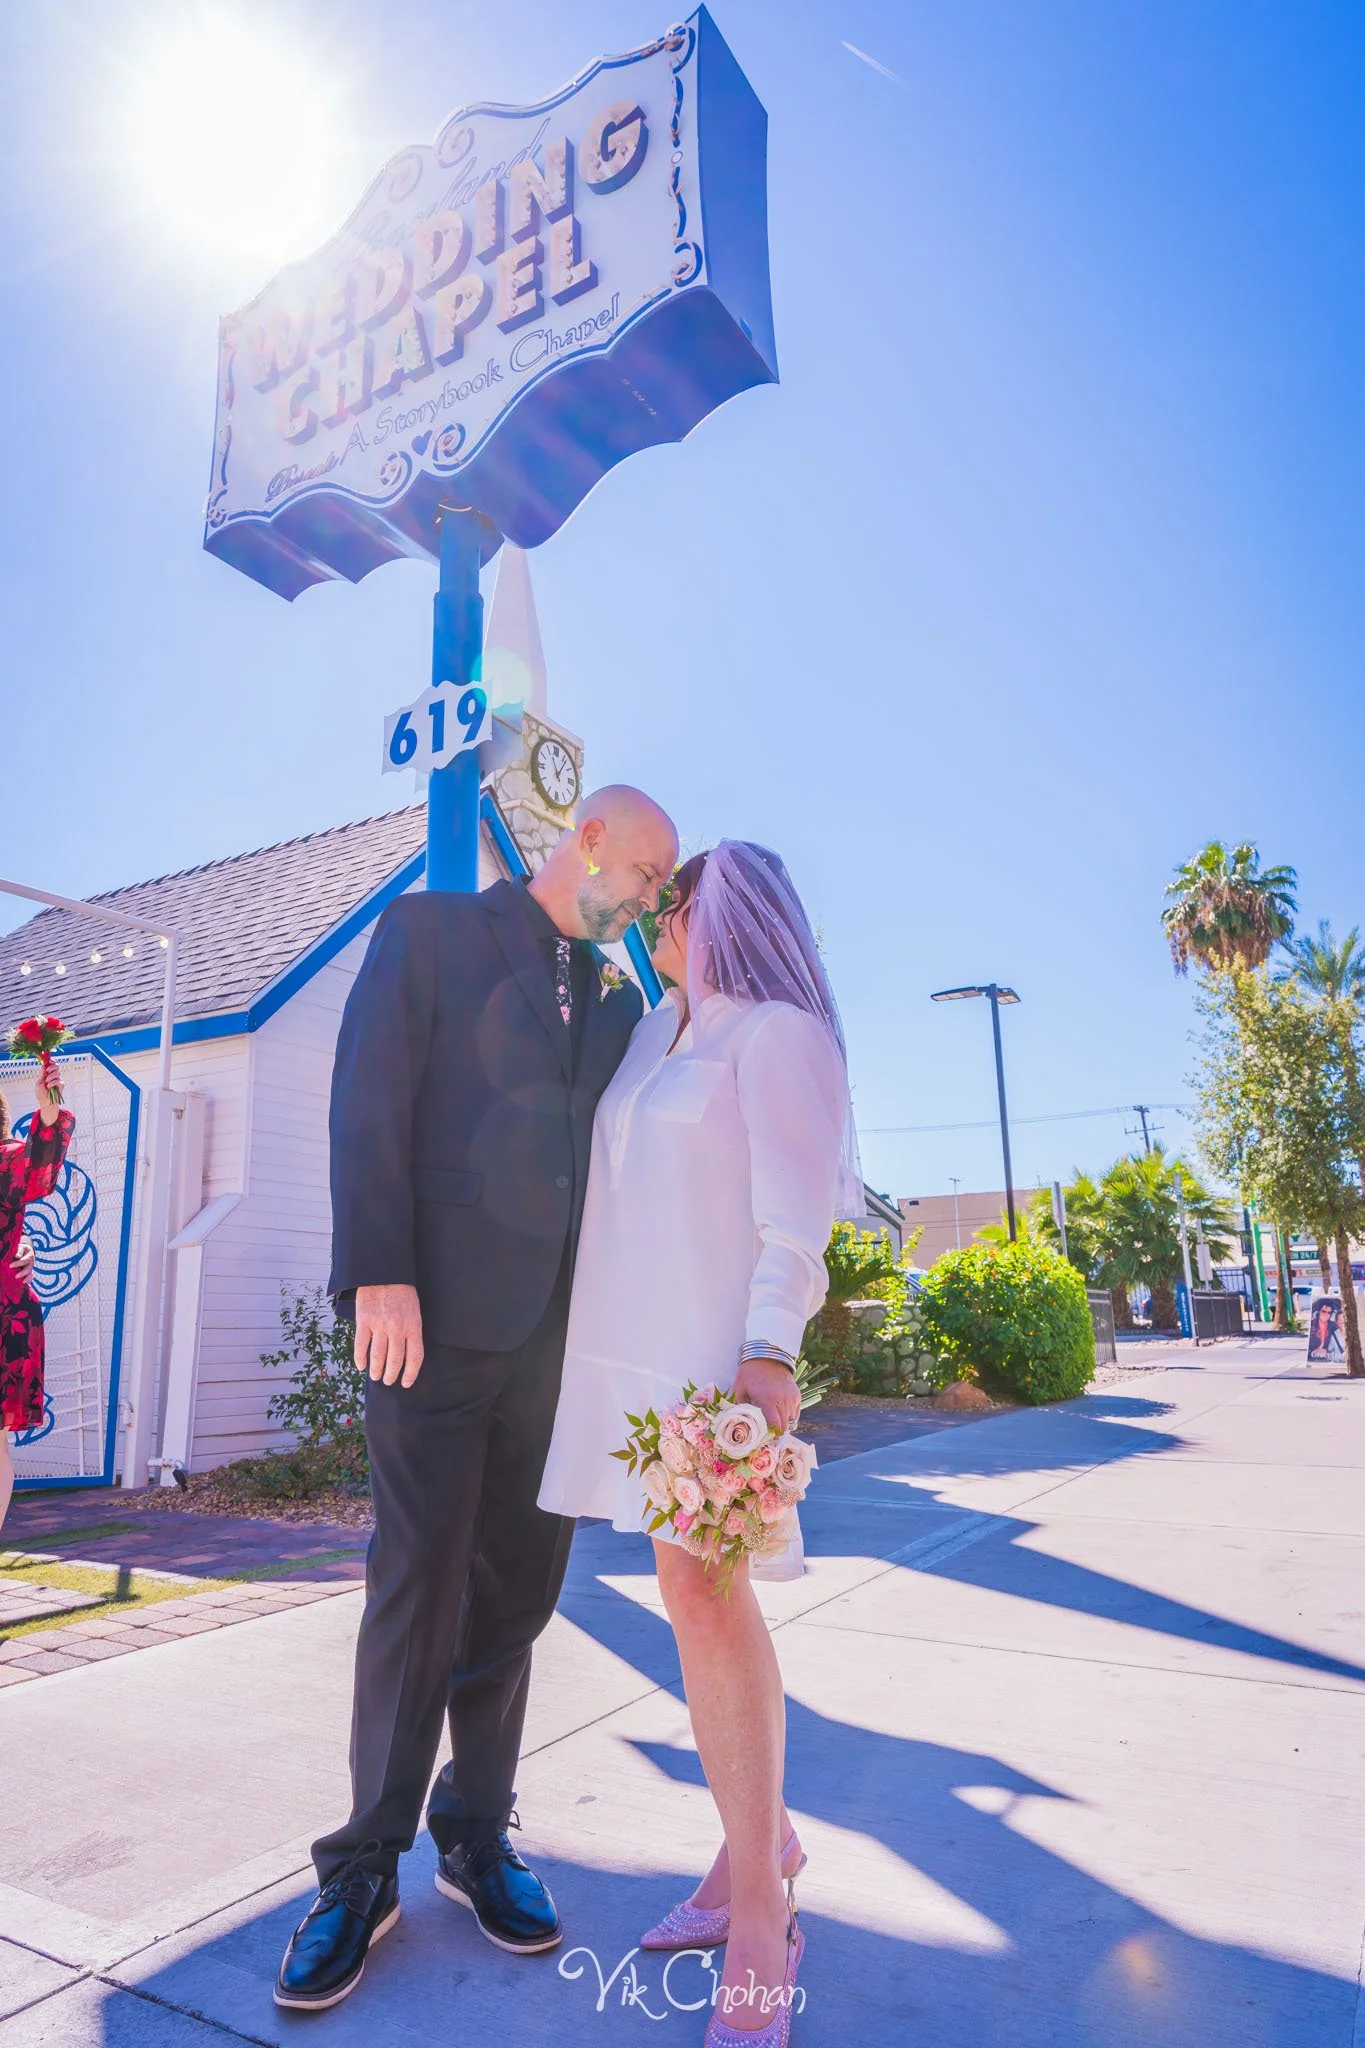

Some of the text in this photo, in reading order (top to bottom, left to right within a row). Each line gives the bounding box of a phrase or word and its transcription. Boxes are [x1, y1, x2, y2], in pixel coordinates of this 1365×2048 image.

[242, 101, 650, 394] WEDDING
[276, 213, 599, 445] CHAPEL
[340, 422, 370, 466] A
[373, 357, 505, 447] Storybook
[509, 292, 621, 373] Chapel
[388, 687, 488, 766] 619
